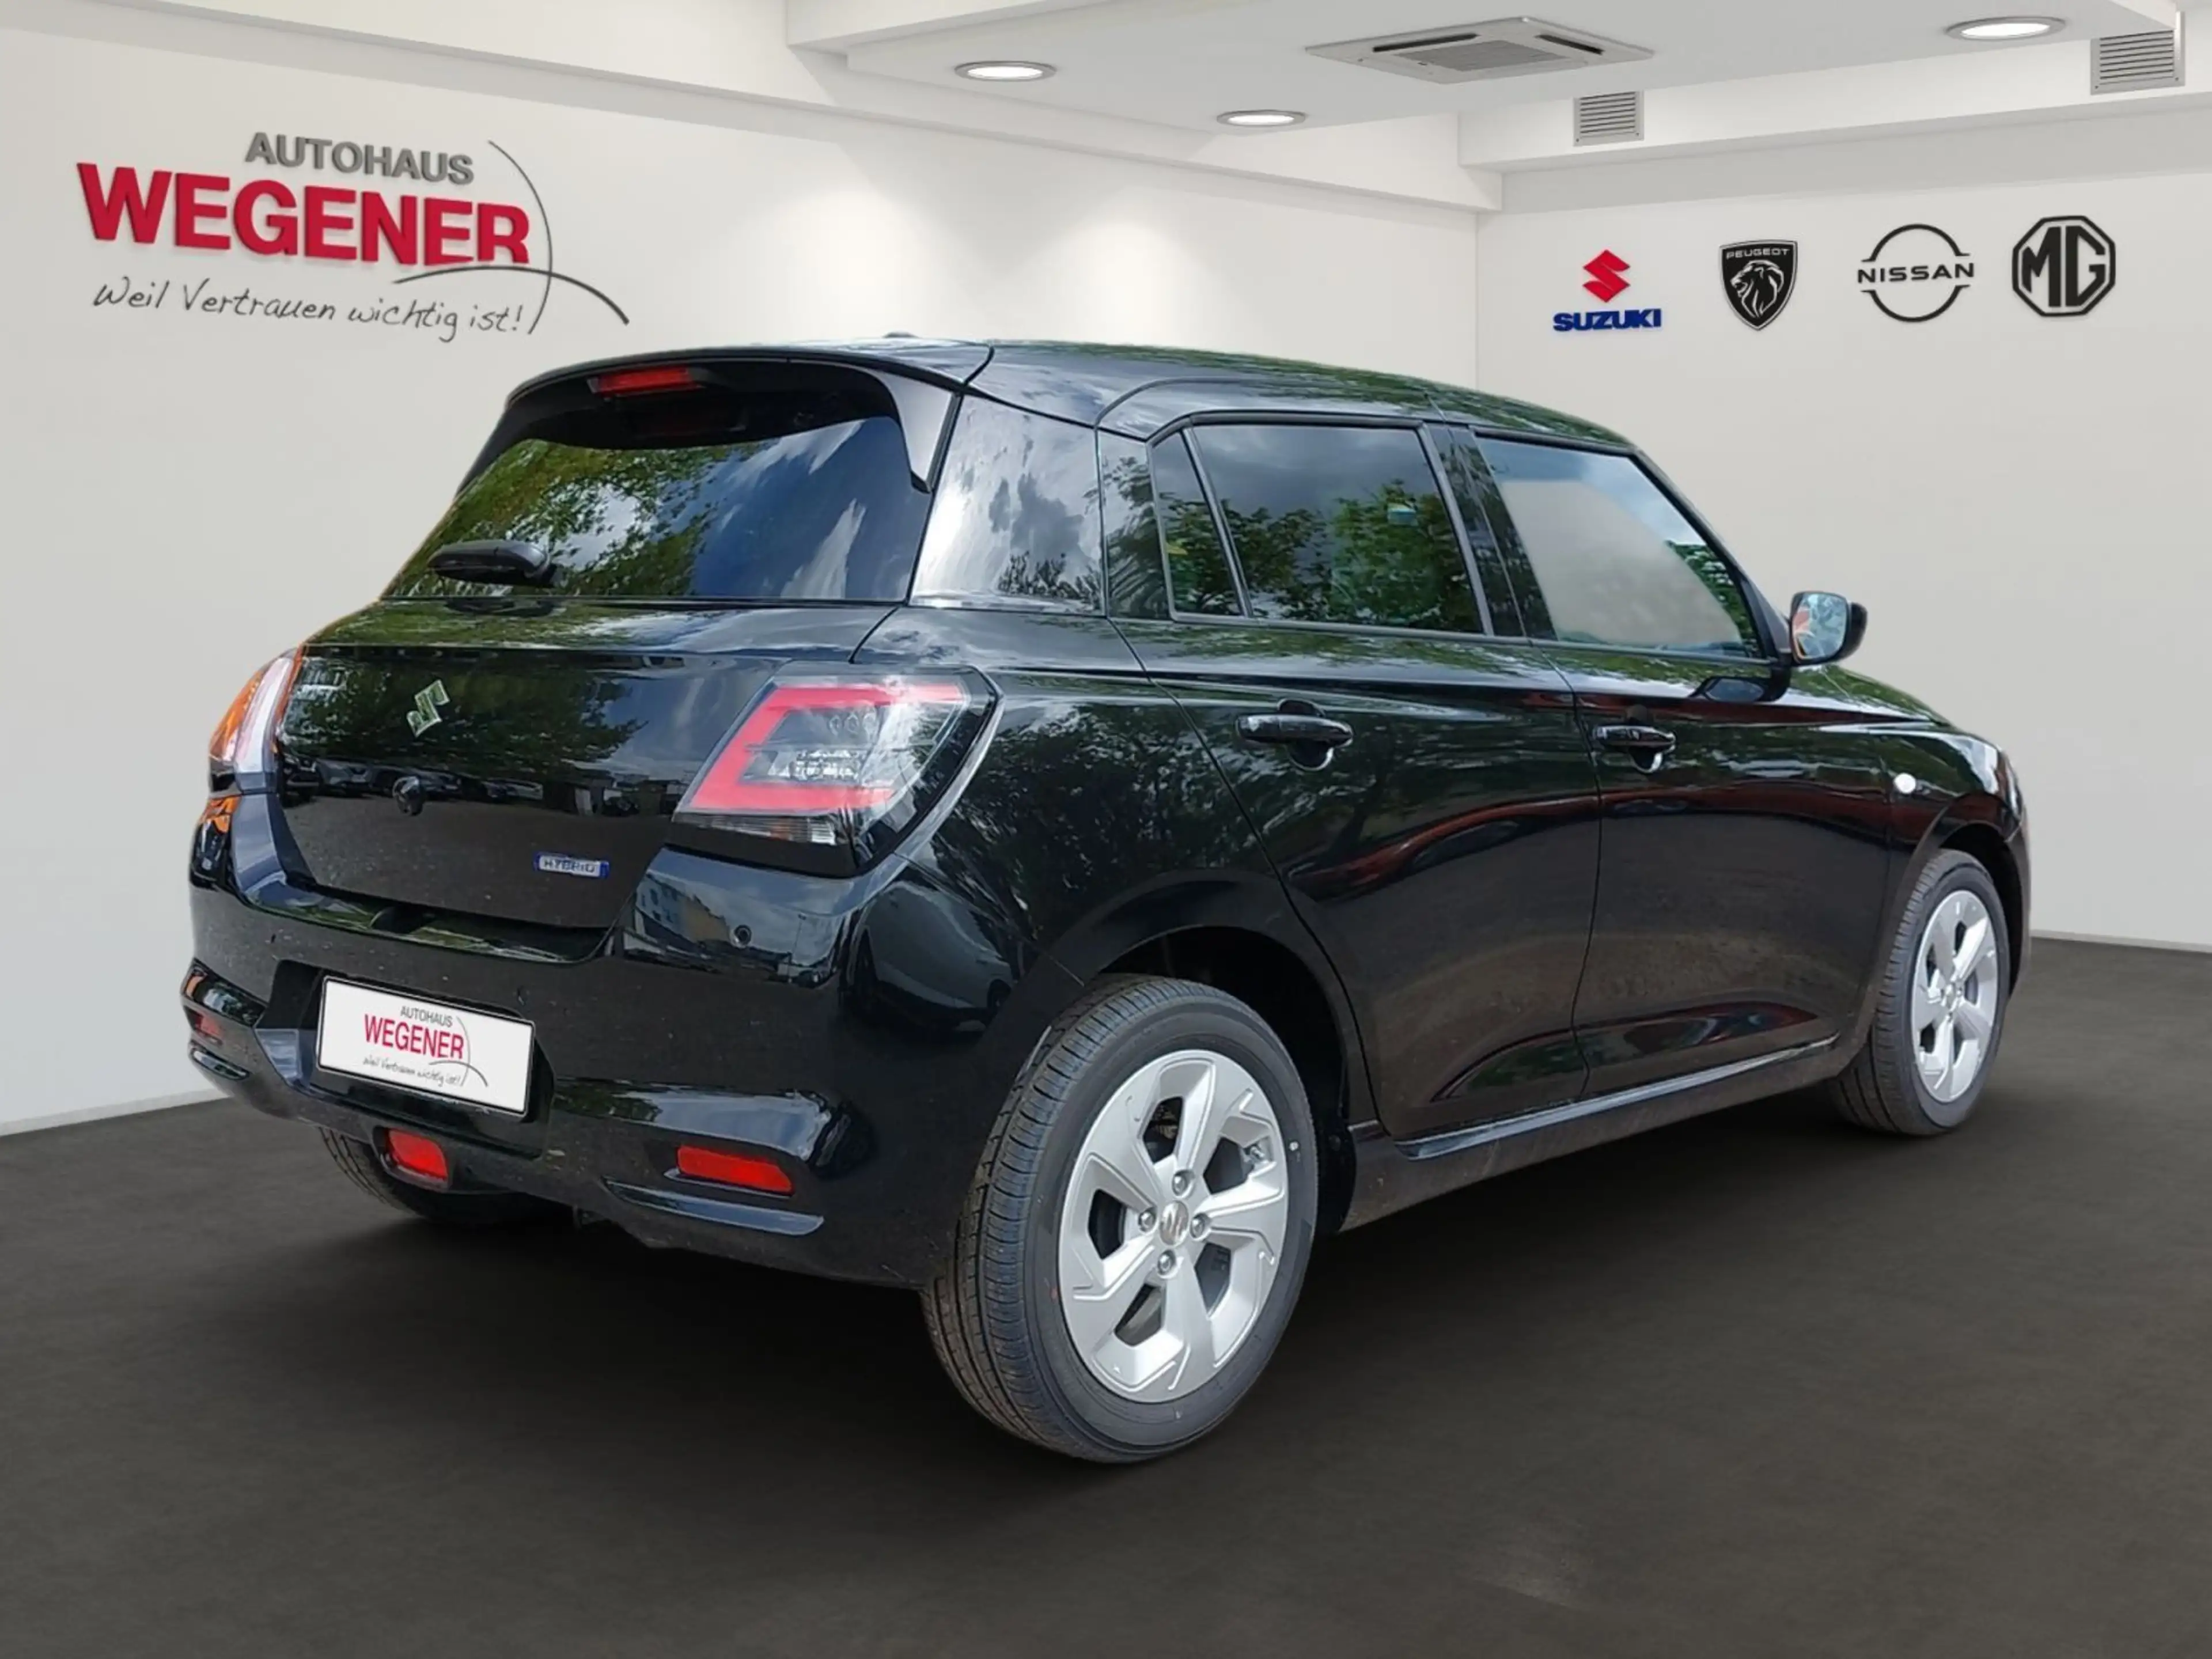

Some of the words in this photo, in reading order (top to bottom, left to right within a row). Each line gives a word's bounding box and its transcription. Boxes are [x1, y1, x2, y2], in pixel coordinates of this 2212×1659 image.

[244, 132, 474, 185] AUTOHAUS
[76, 162, 531, 267] WEGENER
[1726, 246, 1790, 259] PEUGEOT
[1857, 263, 1974, 285] NISSAN
[2022, 225, 2107, 309] MG
[93, 276, 170, 310] Weil
[183, 278, 336, 320] Vertrauen
[348, 304, 459, 343] wichtig
[469, 311, 522, 333] ist!
[1552, 308, 1662, 332] SUZUKI
[364, 1014, 464, 1059] WEGENER
[400, 1006, 453, 1027] AUTOHAUS
